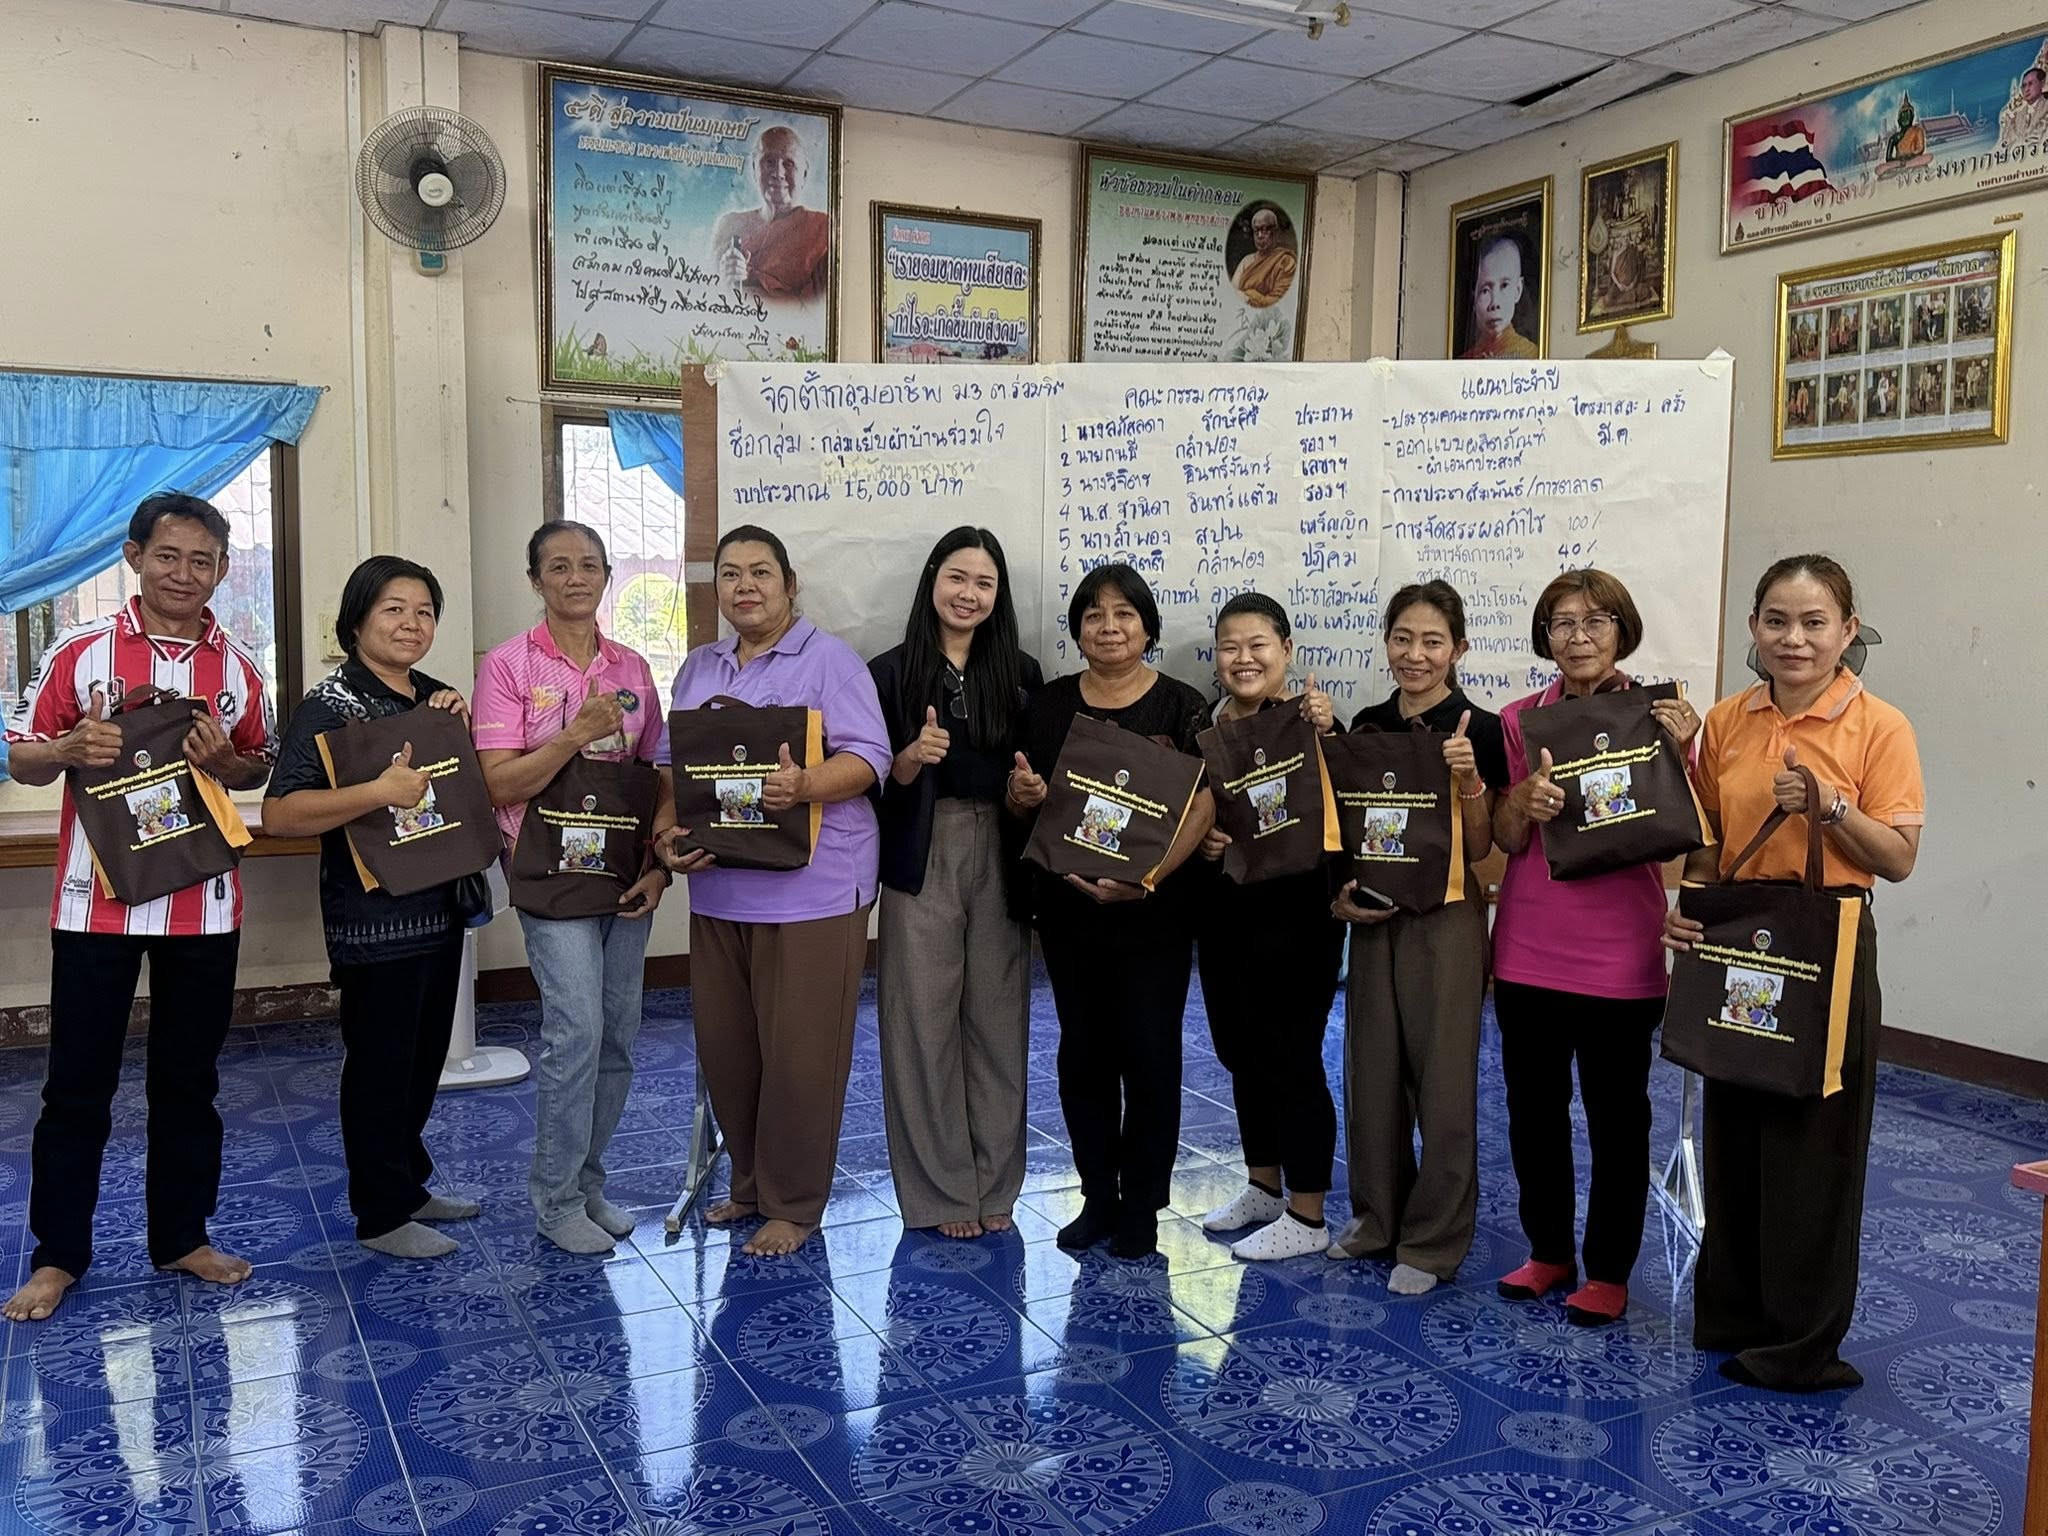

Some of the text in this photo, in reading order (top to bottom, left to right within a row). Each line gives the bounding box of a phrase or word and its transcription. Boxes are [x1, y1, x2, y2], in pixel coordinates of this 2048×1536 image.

[1461, 367, 1560, 399] แผนประจำปี
[1295, 403, 1353, 425] ประธาน
[1061, 452, 1071, 467] 2
[844, 480, 910, 503] 15,000
[922, 476, 964, 497] บาท
[1062, 478, 1072, 497] 3
[1059, 503, 1071, 522] 4
[1059, 528, 1070, 550] 5
[1059, 555, 1069, 572] 6
[1059, 584, 1069, 600] 7
[1056, 640, 1066, 660] 9
